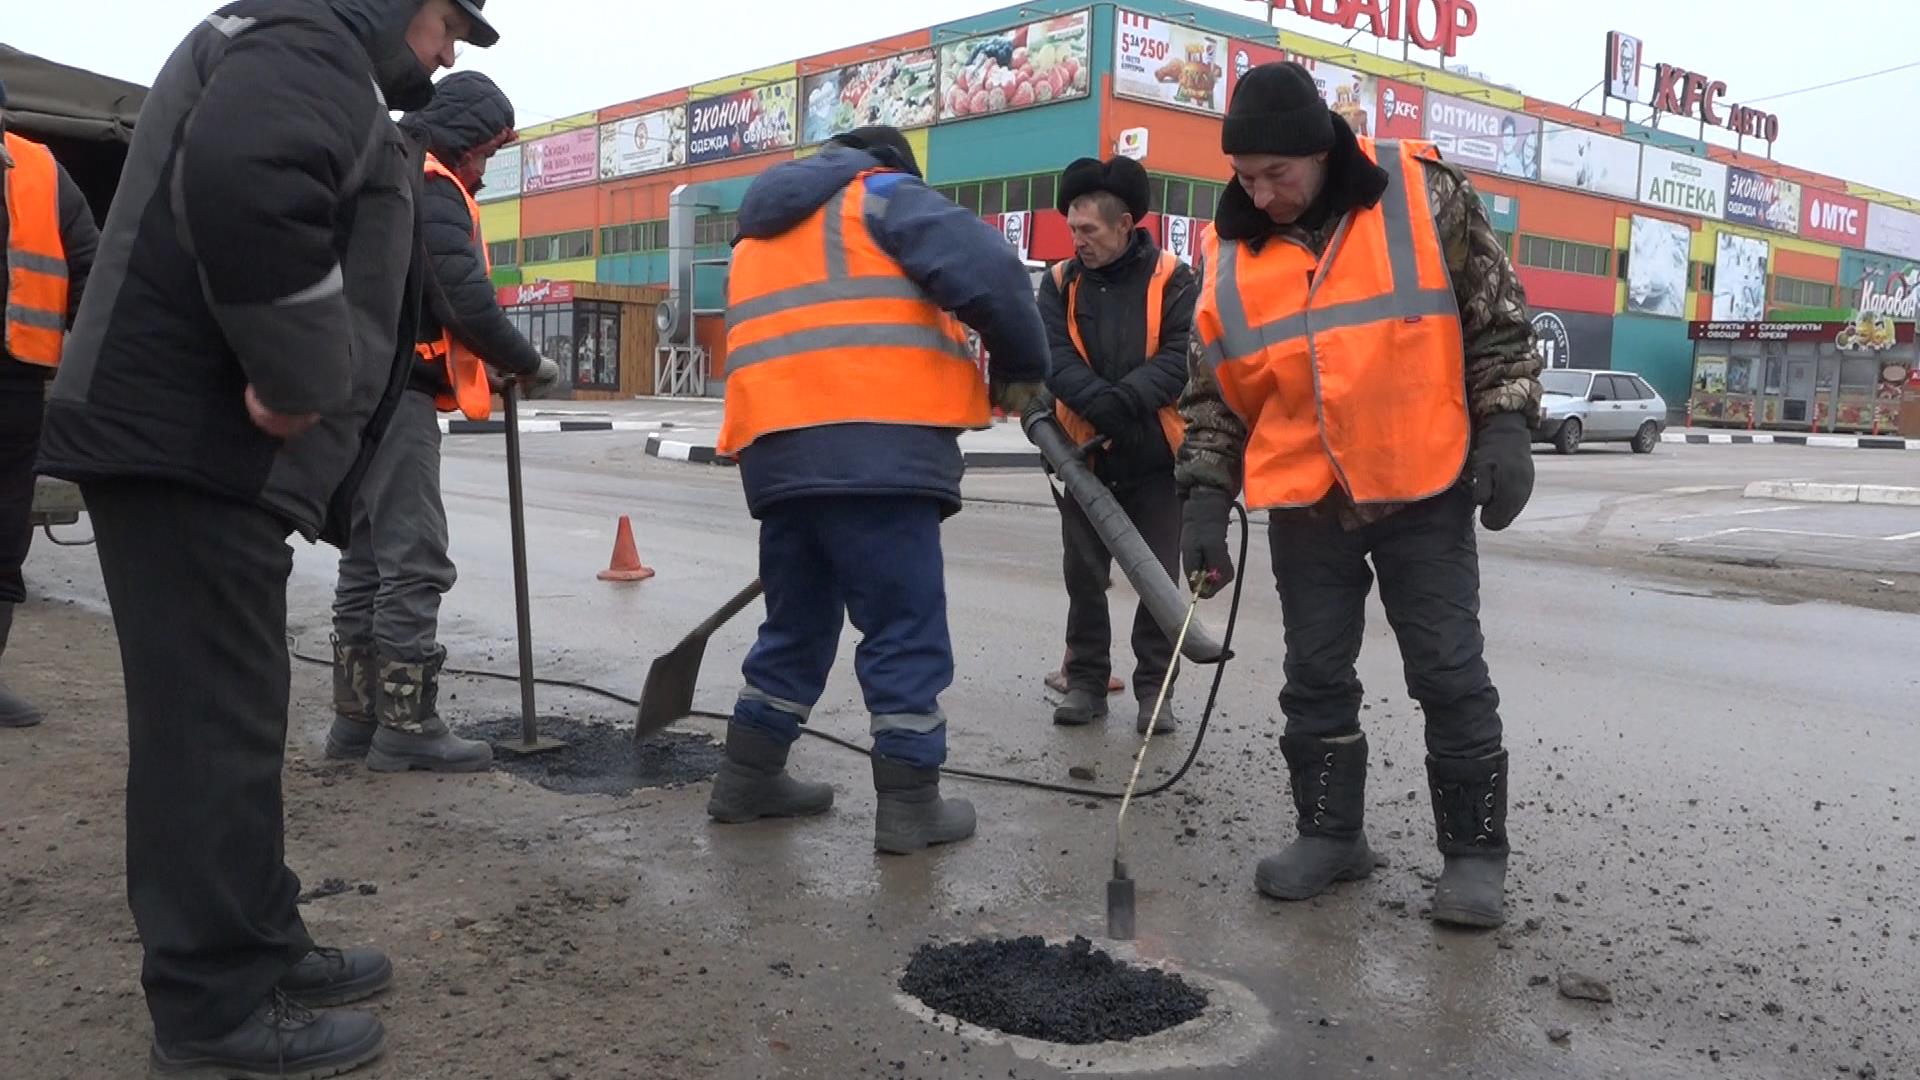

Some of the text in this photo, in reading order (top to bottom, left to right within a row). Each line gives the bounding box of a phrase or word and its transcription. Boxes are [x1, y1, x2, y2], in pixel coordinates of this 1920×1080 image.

[1122, 32, 1130, 53] 5
[1395, 101, 1419, 120] KFC
[1650, 62, 1778, 142] KFC АВТО
[692, 98, 752, 133] ЭКОНОМ
[690, 135, 729, 154] ОДЕЖДА
[1649, 176, 1717, 214] АПТЕКА
[1729, 174, 1775, 204] ЭКОНОМ
[1727, 201, 1757, 218] ОДЕЖДА
[1822, 201, 1858, 235] МТС
[1860, 280, 1916, 318] Караван
[1706, 331, 1789, 340] ОВОЩИ ОРЕХИ
[1707, 323, 1823, 332] ФРУКТЫ СУХОФРУКТЫ
